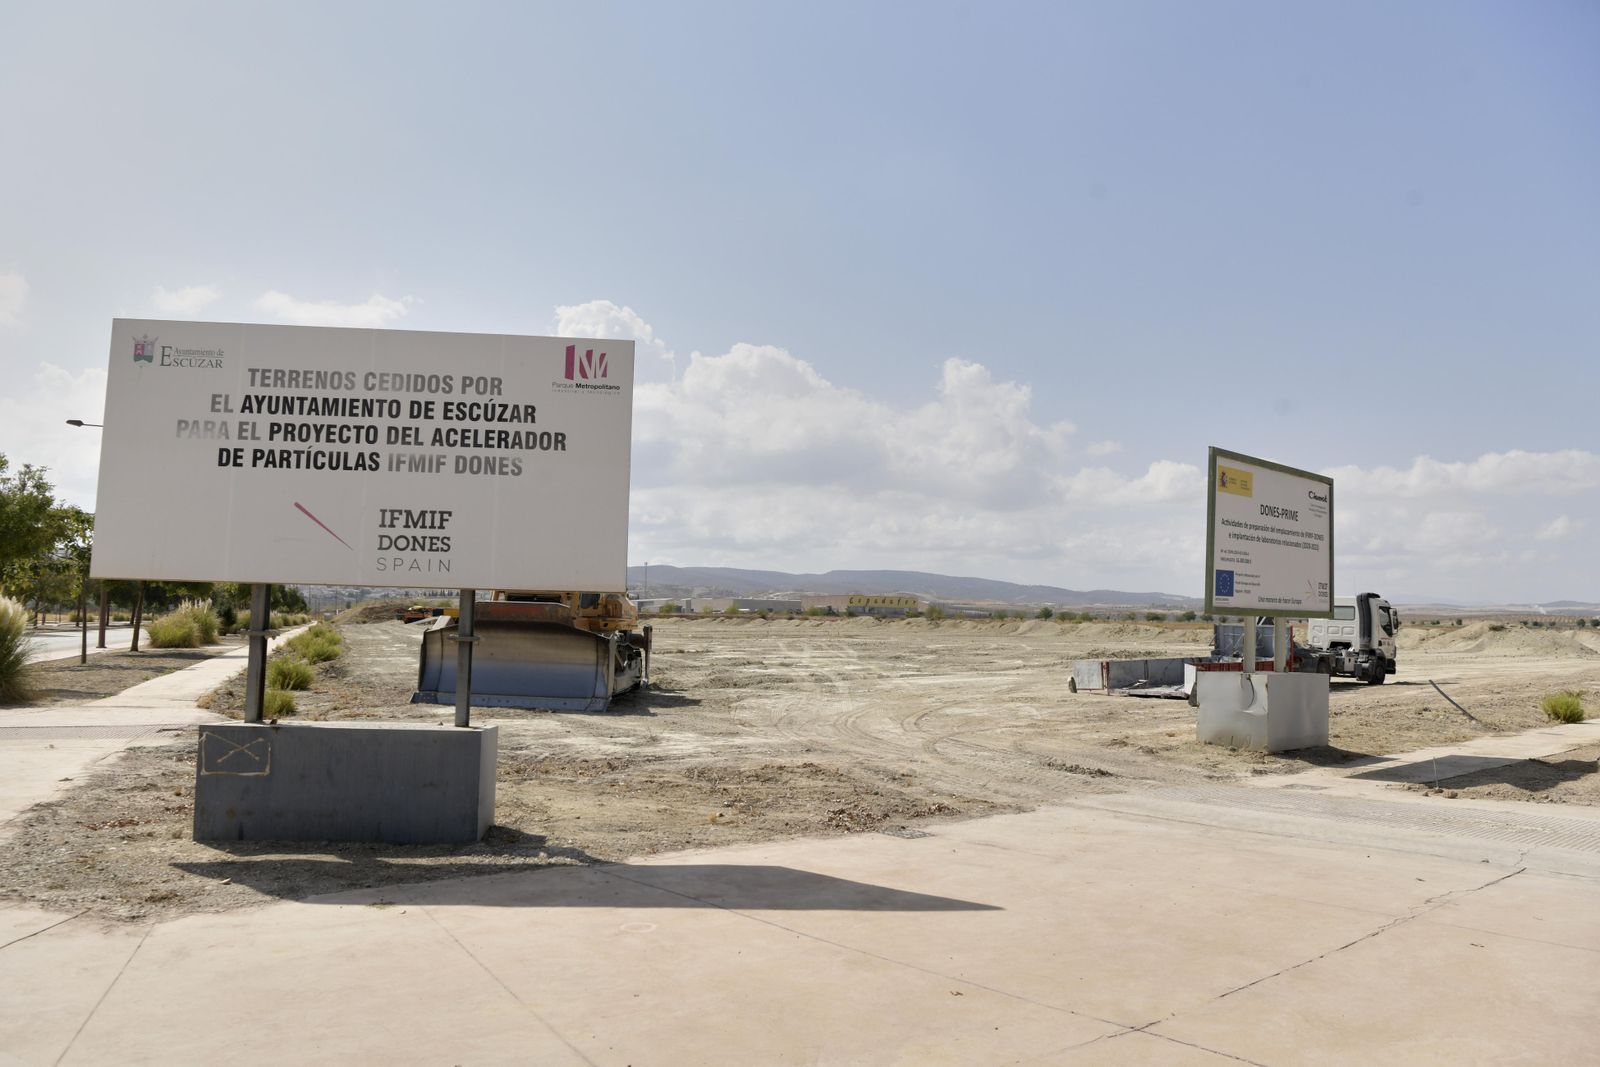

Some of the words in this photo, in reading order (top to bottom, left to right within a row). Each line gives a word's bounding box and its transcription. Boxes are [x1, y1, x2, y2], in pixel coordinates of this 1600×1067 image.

[216, 348, 224, 357] de
[248, 368, 356, 391] TERRENOS
[363, 371, 454, 394] CEDIDOS
[461, 376, 503, 396] POR
[551, 381, 574, 390] Parque
[210, 394, 234, 413] EL
[240, 394, 401, 419] AYUNTAMIENTO
[409, 400, 435, 420] DE
[443, 398, 536, 424] ESCÚZAR
[176, 419, 230, 440] PARA
[237, 421, 261, 441] EL
[268, 422, 379, 445] PROYECTO
[386, 426, 424, 446] DEL
[431, 428, 567, 451] ACELERADOR
[218, 447, 244, 467] DE
[252, 445, 381, 472] PARTÍCULAS
[387, 452, 447, 473] IFMIF
[454, 455, 523, 476] DONES
[379, 508, 452, 529] IFMIF
[1260, 504, 1298, 521] DONES-PRIME
[377, 534, 451, 552] DONES
[376, 557, 451, 572] SPAIN
